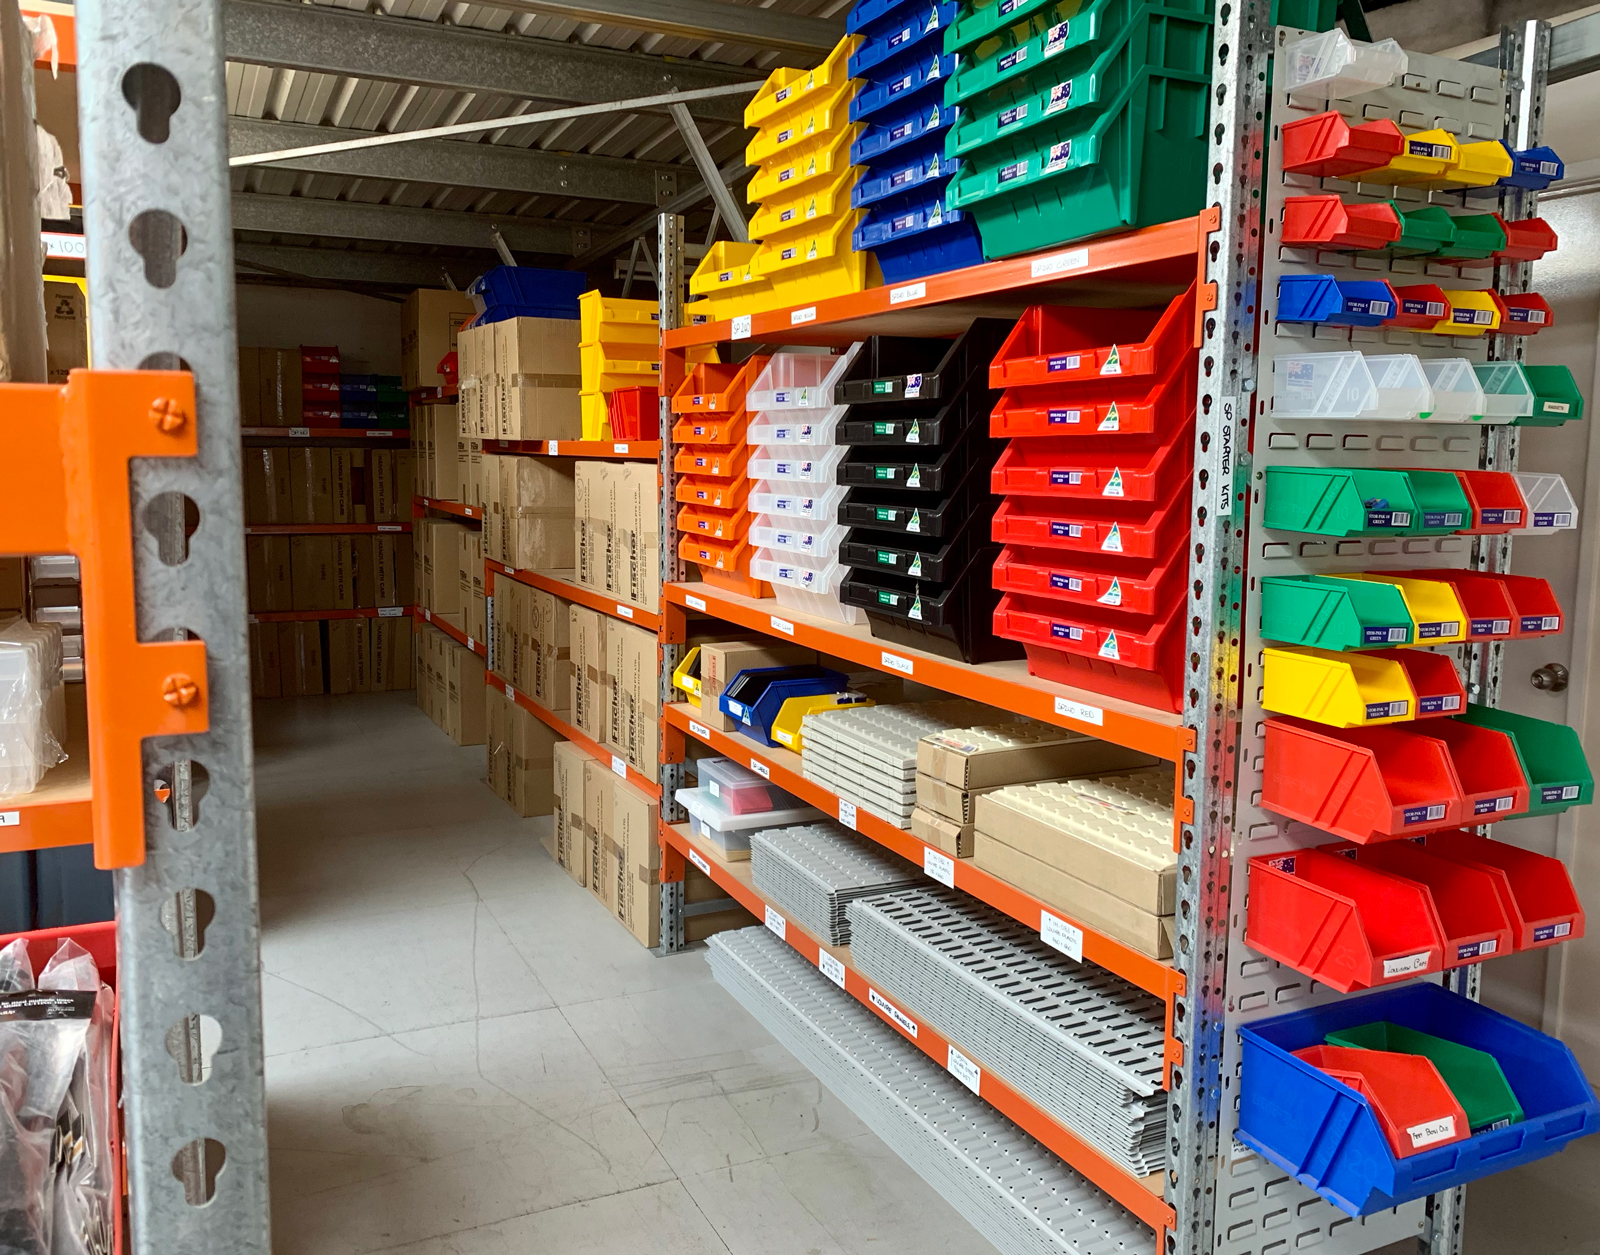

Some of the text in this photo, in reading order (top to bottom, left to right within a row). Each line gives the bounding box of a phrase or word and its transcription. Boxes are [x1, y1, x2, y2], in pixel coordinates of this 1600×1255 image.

[59, 241, 85, 253] 100
[1033, 255, 1080, 273] SP240 GREEN
[906, 289, 918, 298] BLUE
[1347, 387, 1360, 401] 10
[1220, 402, 1233, 510] SP STARTER KITS
[1336, 504, 1349, 520] 10
[1057, 702, 1095, 719] SP240 RED
[617, 850, 625, 922] Fischer
